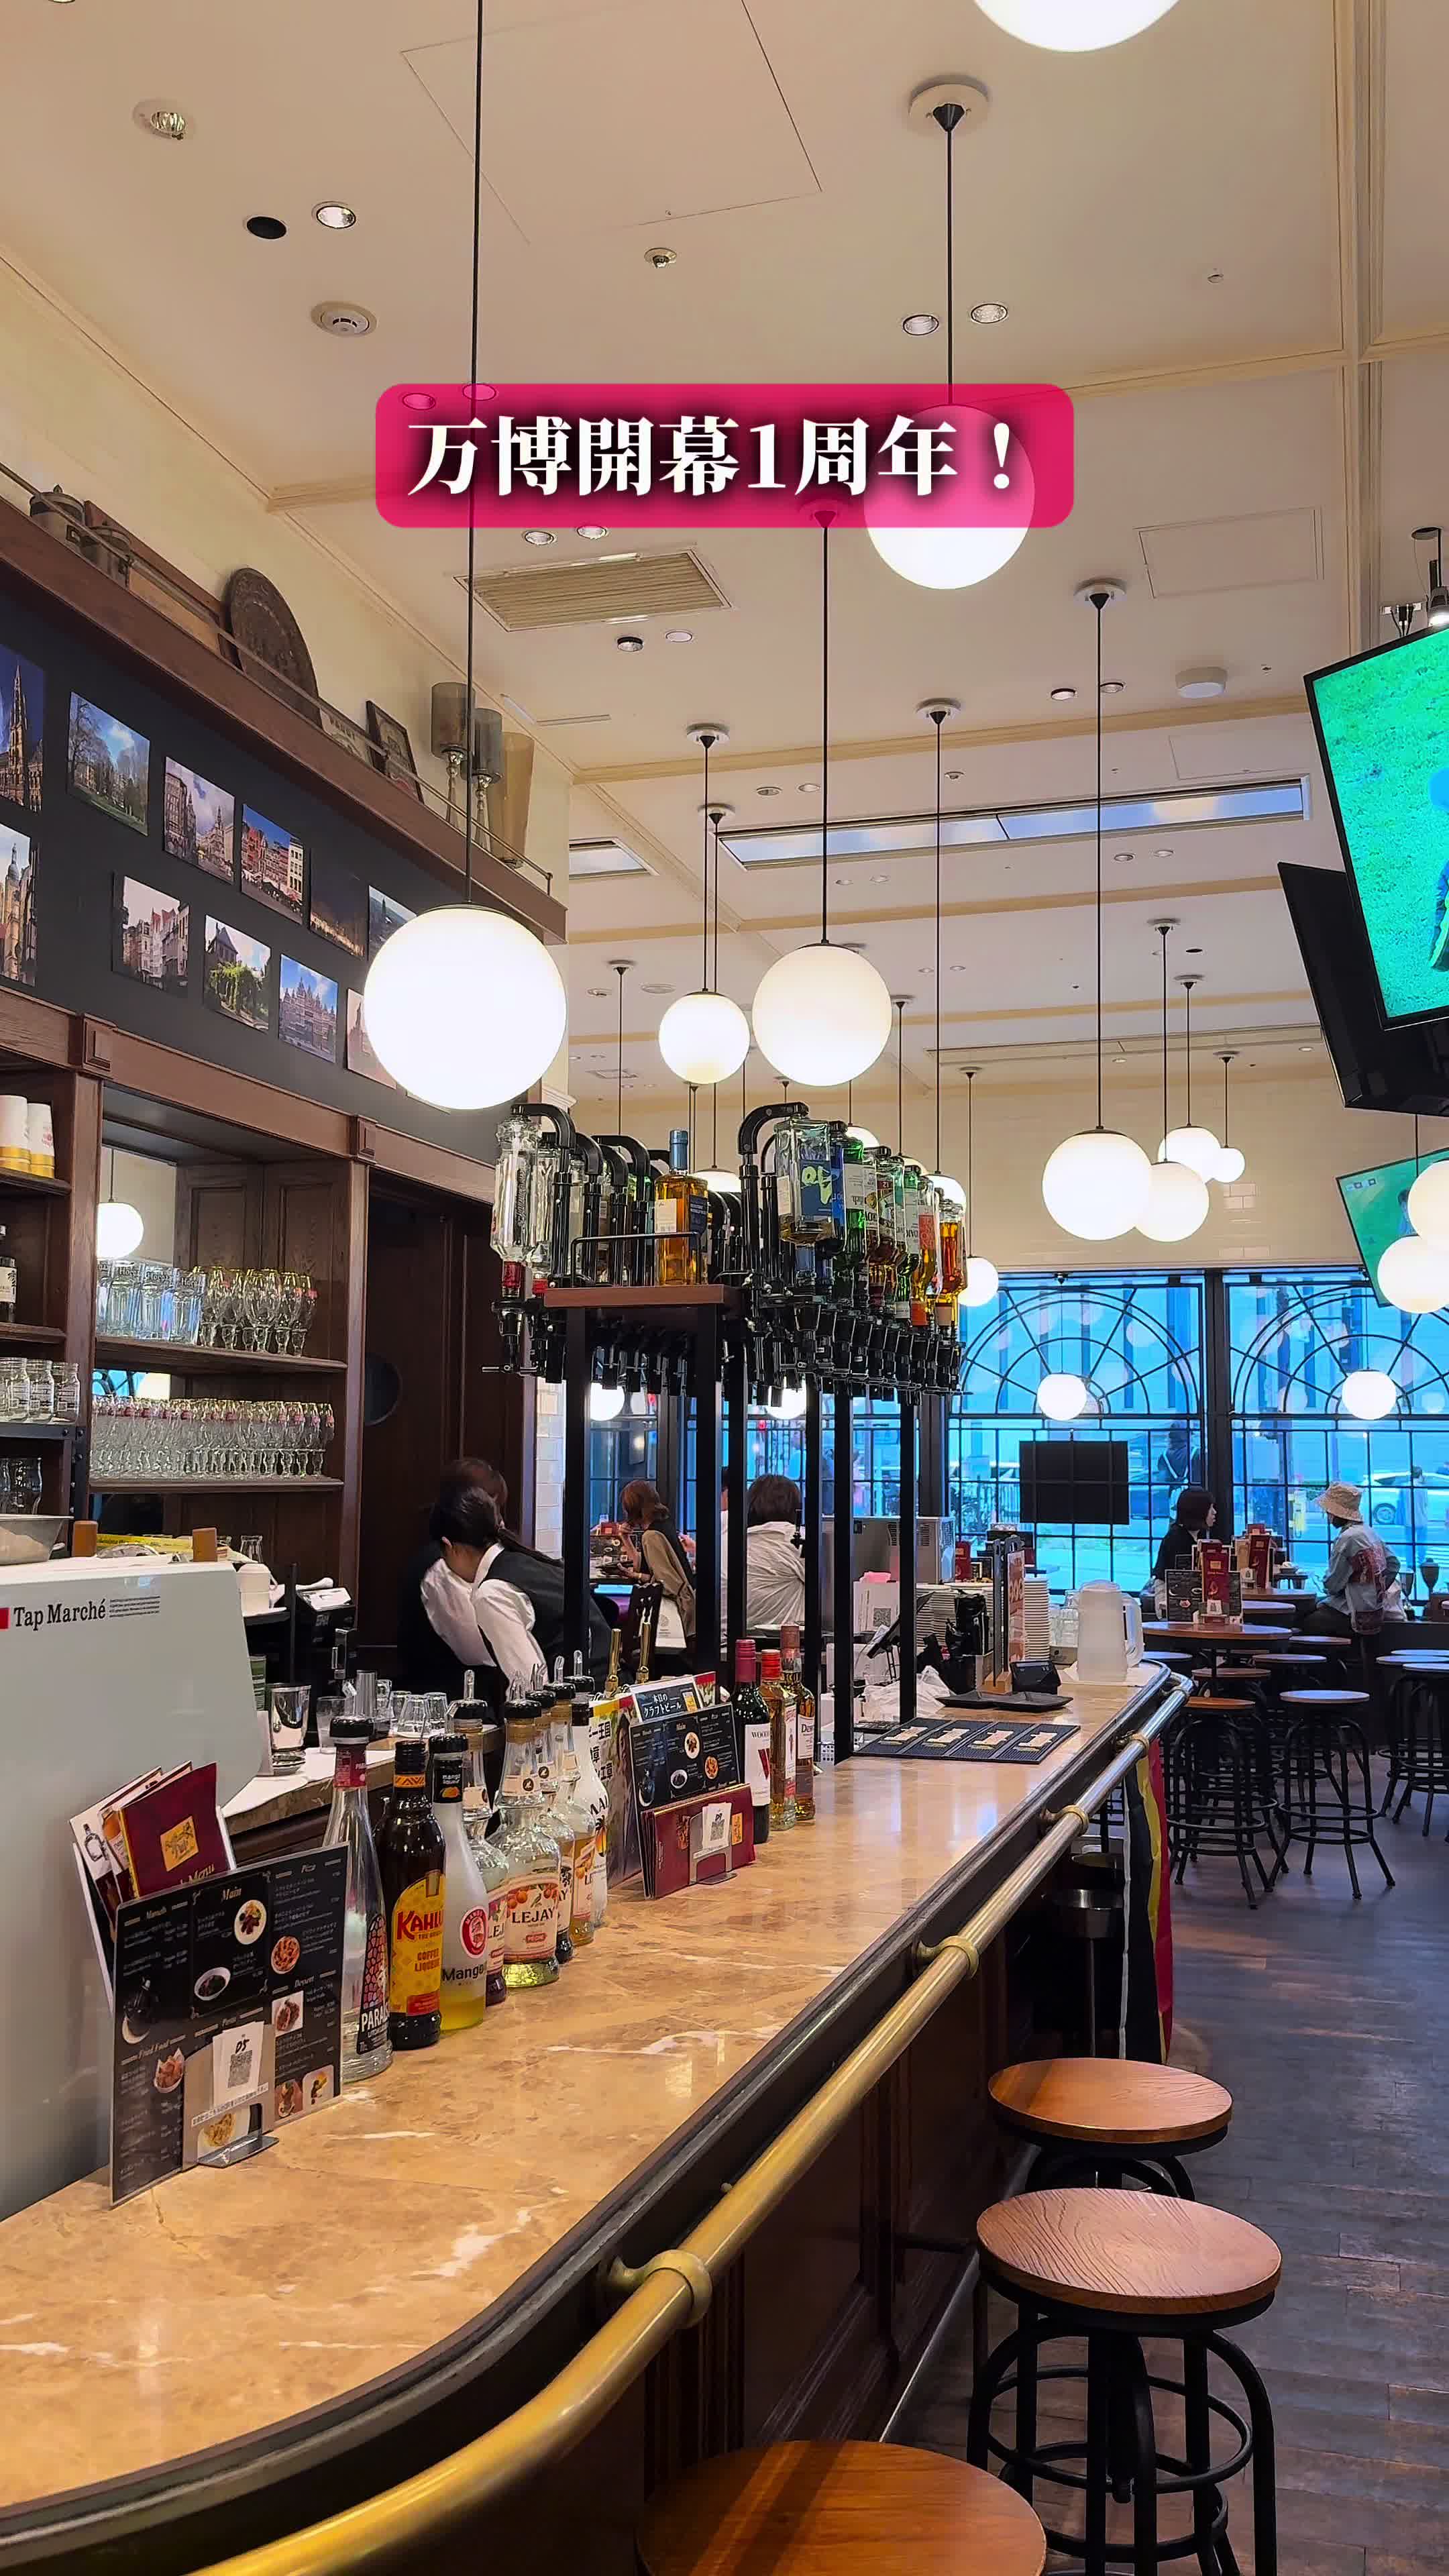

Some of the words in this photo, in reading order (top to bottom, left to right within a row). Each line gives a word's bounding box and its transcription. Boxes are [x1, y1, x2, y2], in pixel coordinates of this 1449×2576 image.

[13, 1607, 44, 1631] Tap
[47, 1599, 106, 1624] Marché
[653, 1693, 668, 1703] 本日の
[644, 1703, 682, 1718] クラフトビール
[221, 1887, 242, 1901] Main
[512, 1907, 556, 1923] LEJAY
[441, 1964, 485, 1982] Mango
